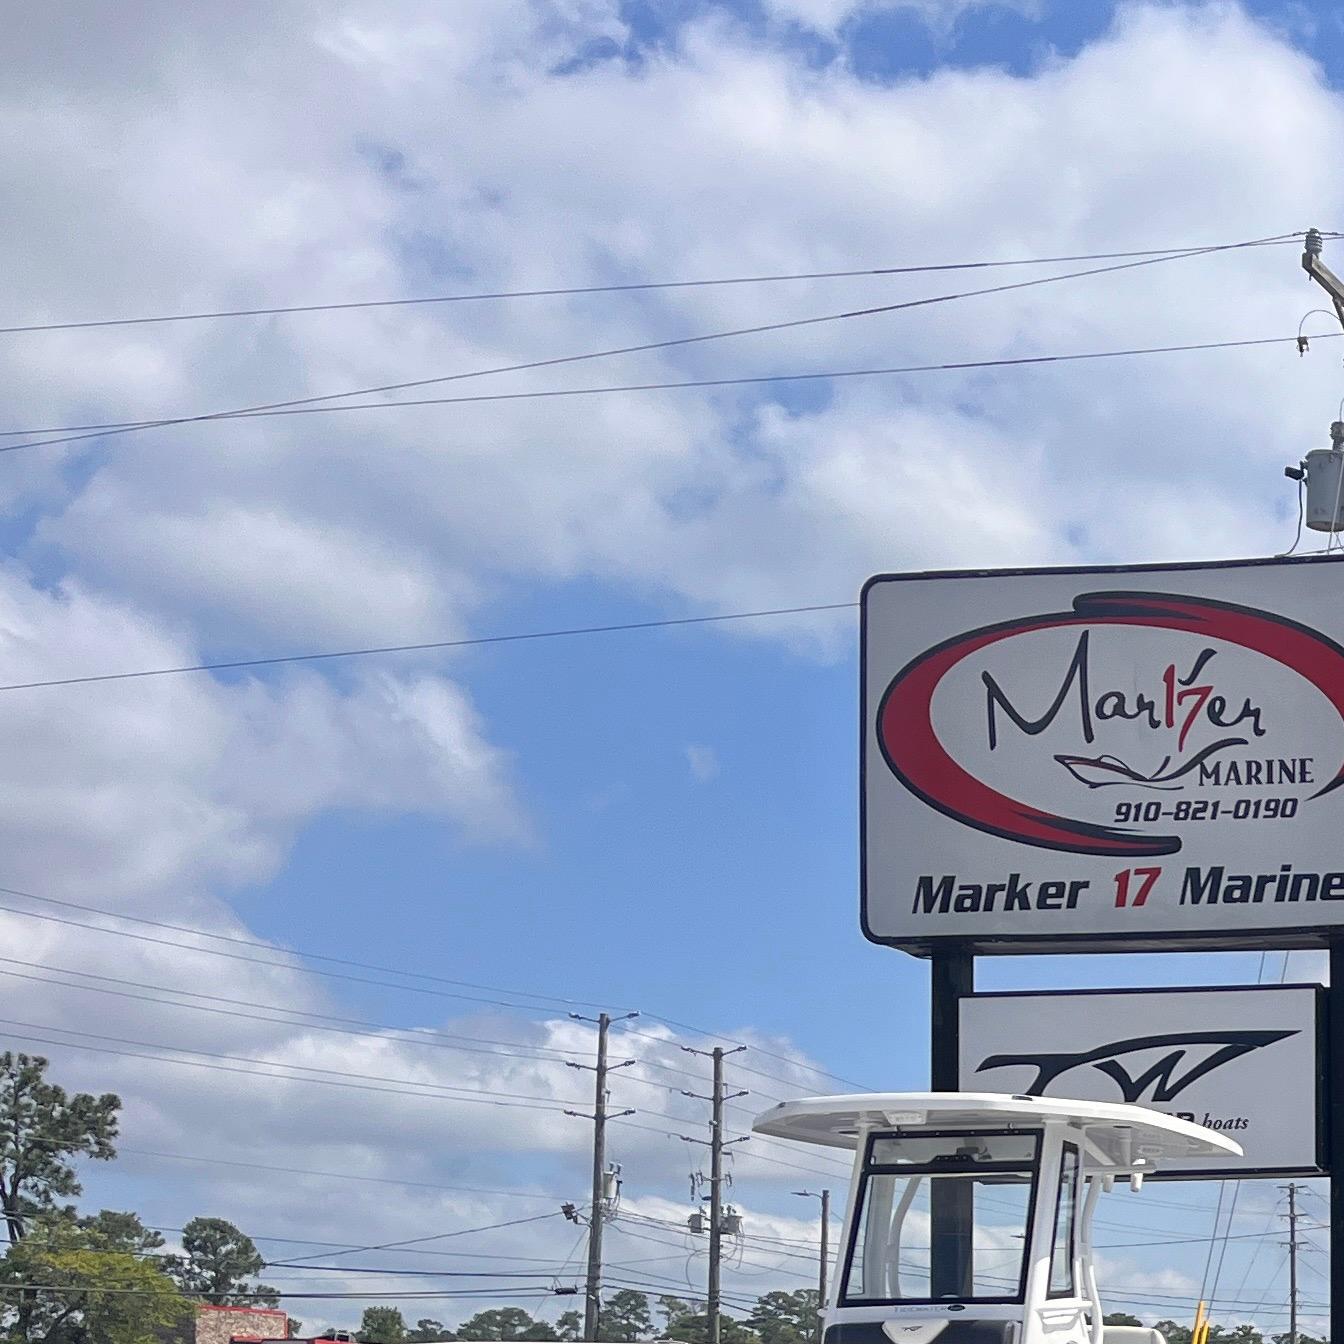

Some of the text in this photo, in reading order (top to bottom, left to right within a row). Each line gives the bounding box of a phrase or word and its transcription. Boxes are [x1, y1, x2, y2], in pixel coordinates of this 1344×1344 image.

[1198, 758, 1314, 787] MARINE
[1114, 798, 1298, 823] 910-821-0190
[912, 873, 1090, 914] Marker
[1113, 867, 1162, 908] 17
[1202, 1112, 1249, 1130] boats
